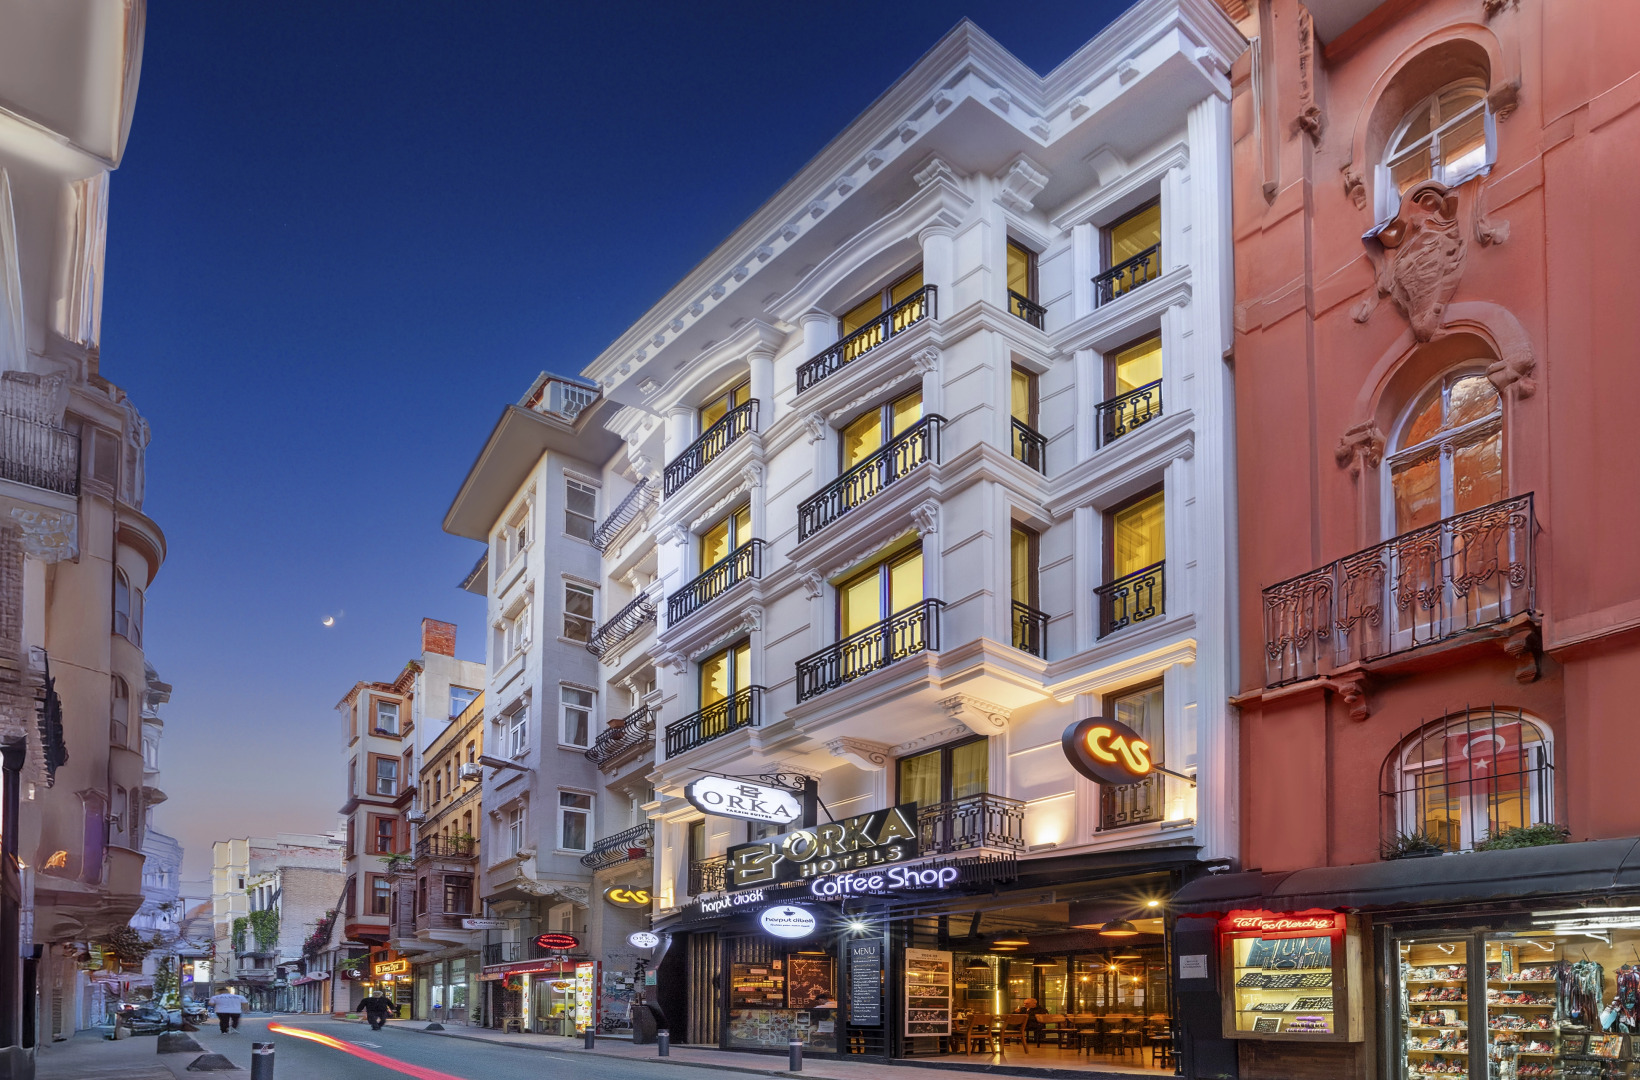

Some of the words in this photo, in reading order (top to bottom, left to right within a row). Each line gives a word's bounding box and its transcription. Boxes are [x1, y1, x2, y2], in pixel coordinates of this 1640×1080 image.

[702, 791, 792, 818] ORKA
[783, 808, 917, 863] ORKA
[801, 846, 903, 878] HOTELS
[811, 874, 885, 896] Coffee
[888, 867, 958, 888] Shop
[701, 896, 732, 913] harput
[853, 946, 875, 955] MENU
